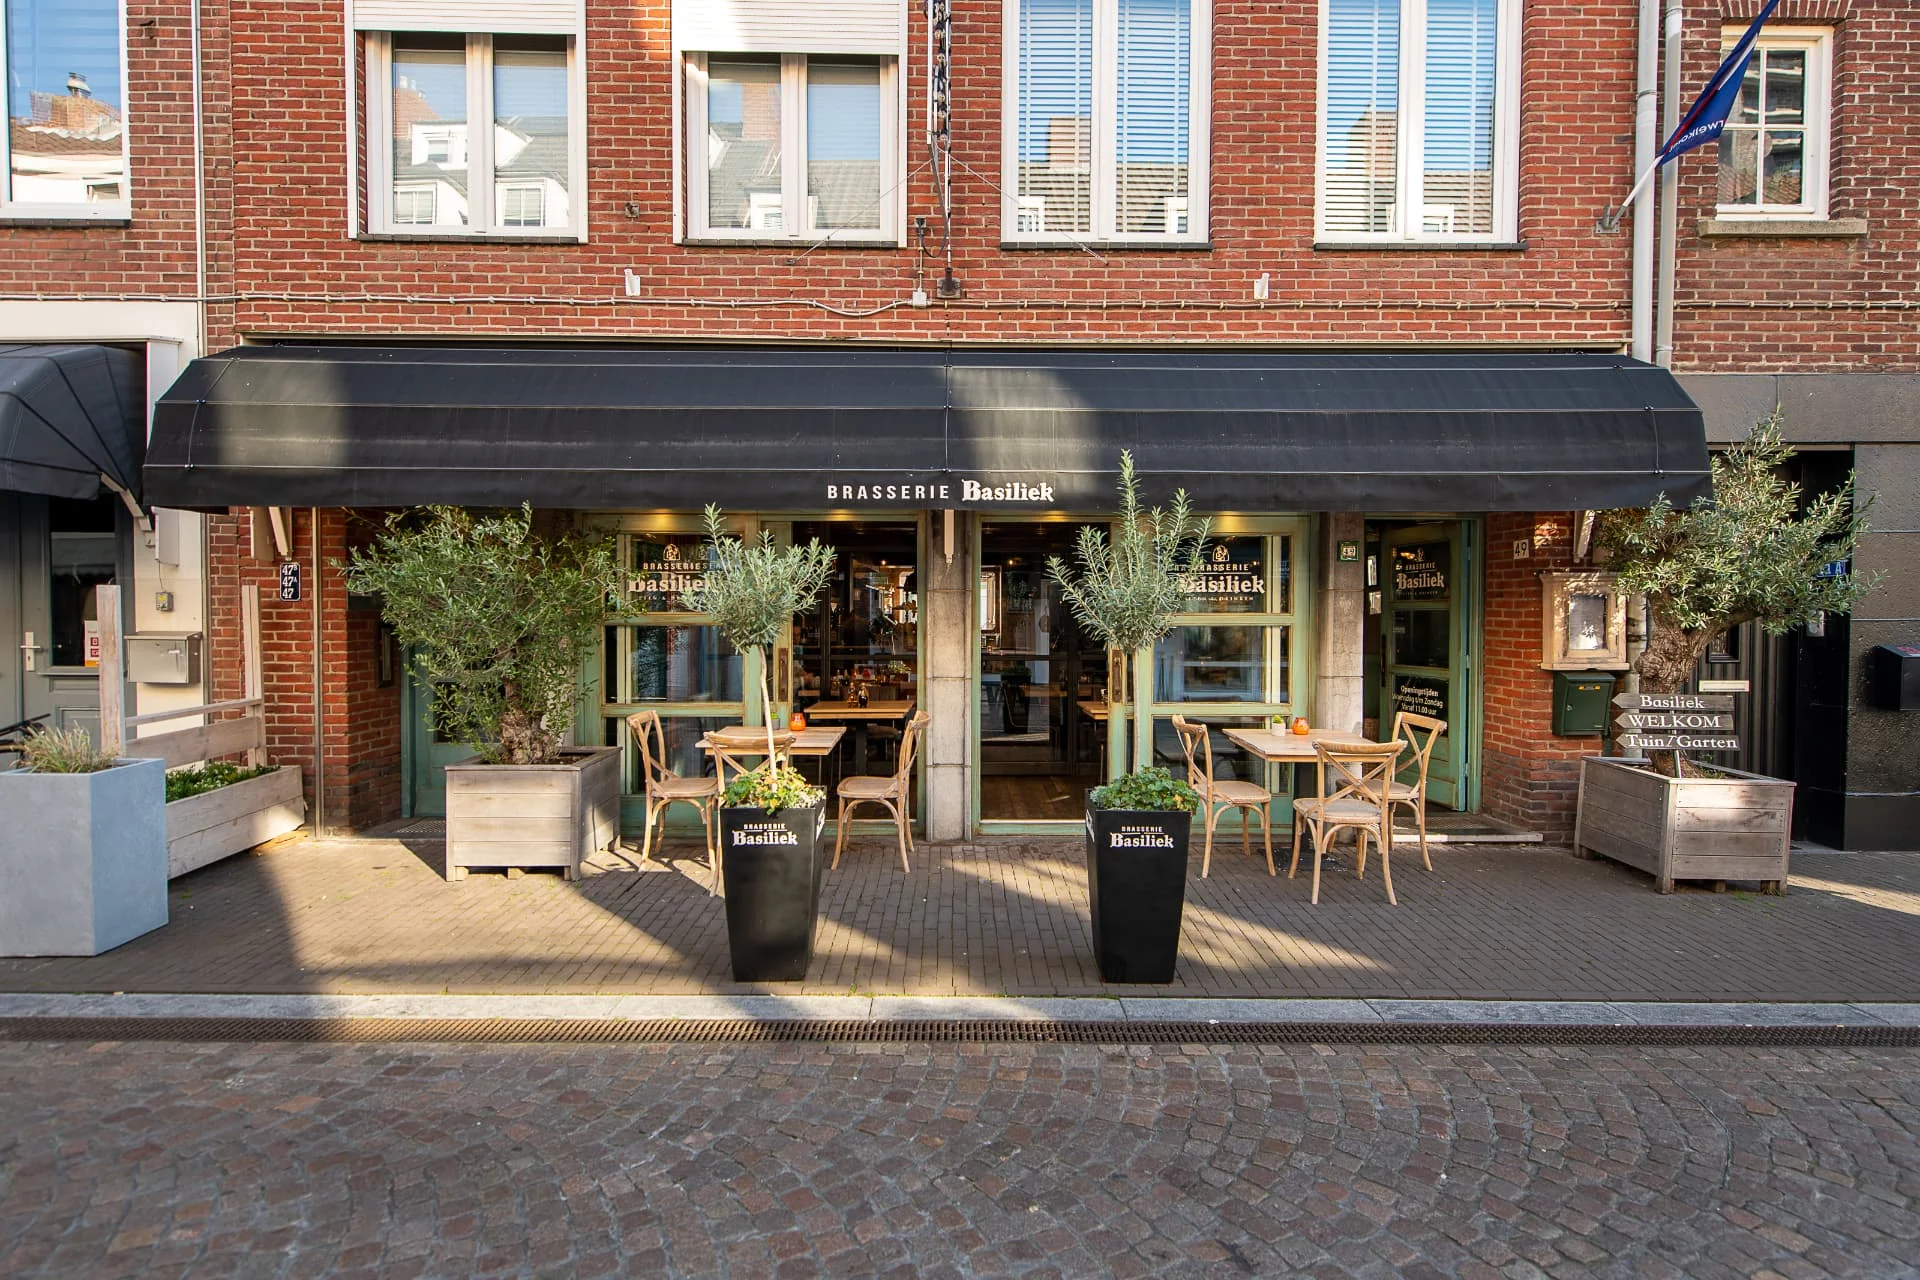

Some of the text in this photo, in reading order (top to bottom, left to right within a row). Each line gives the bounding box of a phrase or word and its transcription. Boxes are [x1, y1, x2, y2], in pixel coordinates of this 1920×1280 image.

[828, 479, 1055, 503] BRASSERIE Basiliek
[1514, 542, 1528, 557] 49
[643, 562, 701, 570] BRASSERIE
[1195, 563, 1249, 571] RASSERIE
[282, 576, 298, 587] 47A
[1395, 571, 1446, 590] Basiliek
[282, 588, 294, 599] 47
[1640, 695, 1704, 709] Basiliek
[1628, 714, 1722, 728] WELKOM
[1626, 734, 1738, 748] Tuin/Garten
[731, 830, 799, 847] Basiliek
[1109, 832, 1174, 849] Basiliek
